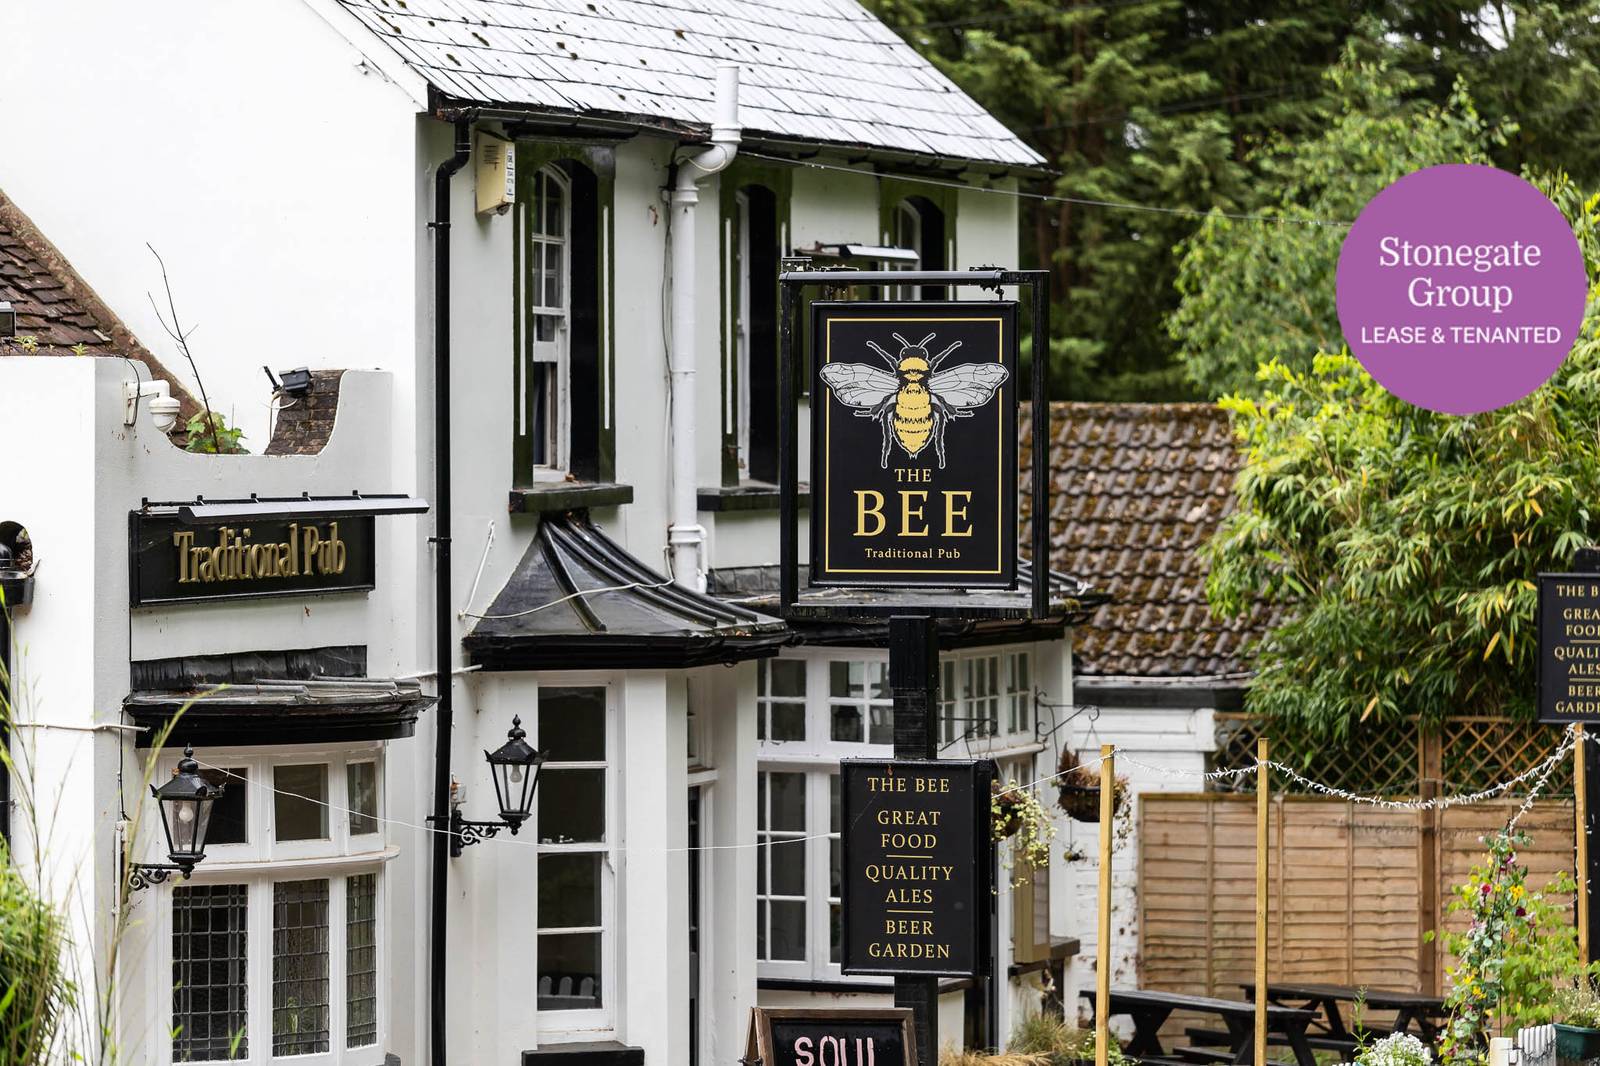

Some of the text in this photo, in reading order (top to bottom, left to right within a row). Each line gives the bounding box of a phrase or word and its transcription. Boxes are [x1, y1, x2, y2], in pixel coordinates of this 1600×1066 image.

[895, 469, 931, 482] THE
[853, 490, 972, 536] BEE
[174, 522, 345, 582] Traditional Pub
[865, 548, 960, 558] Traditional Pub
[1557, 585, 1584, 596] THE
[1567, 625, 1600, 636] FOO
[868, 778, 949, 792] THE BEE
[878, 810, 940, 825] GREAT
[882, 834, 936, 848] FOOD
[866, 865, 953, 882] QUALITY
[886, 889, 932, 903] ALES
[886, 920, 933, 934] BEER
[869, 943, 949, 958] GARDEN
